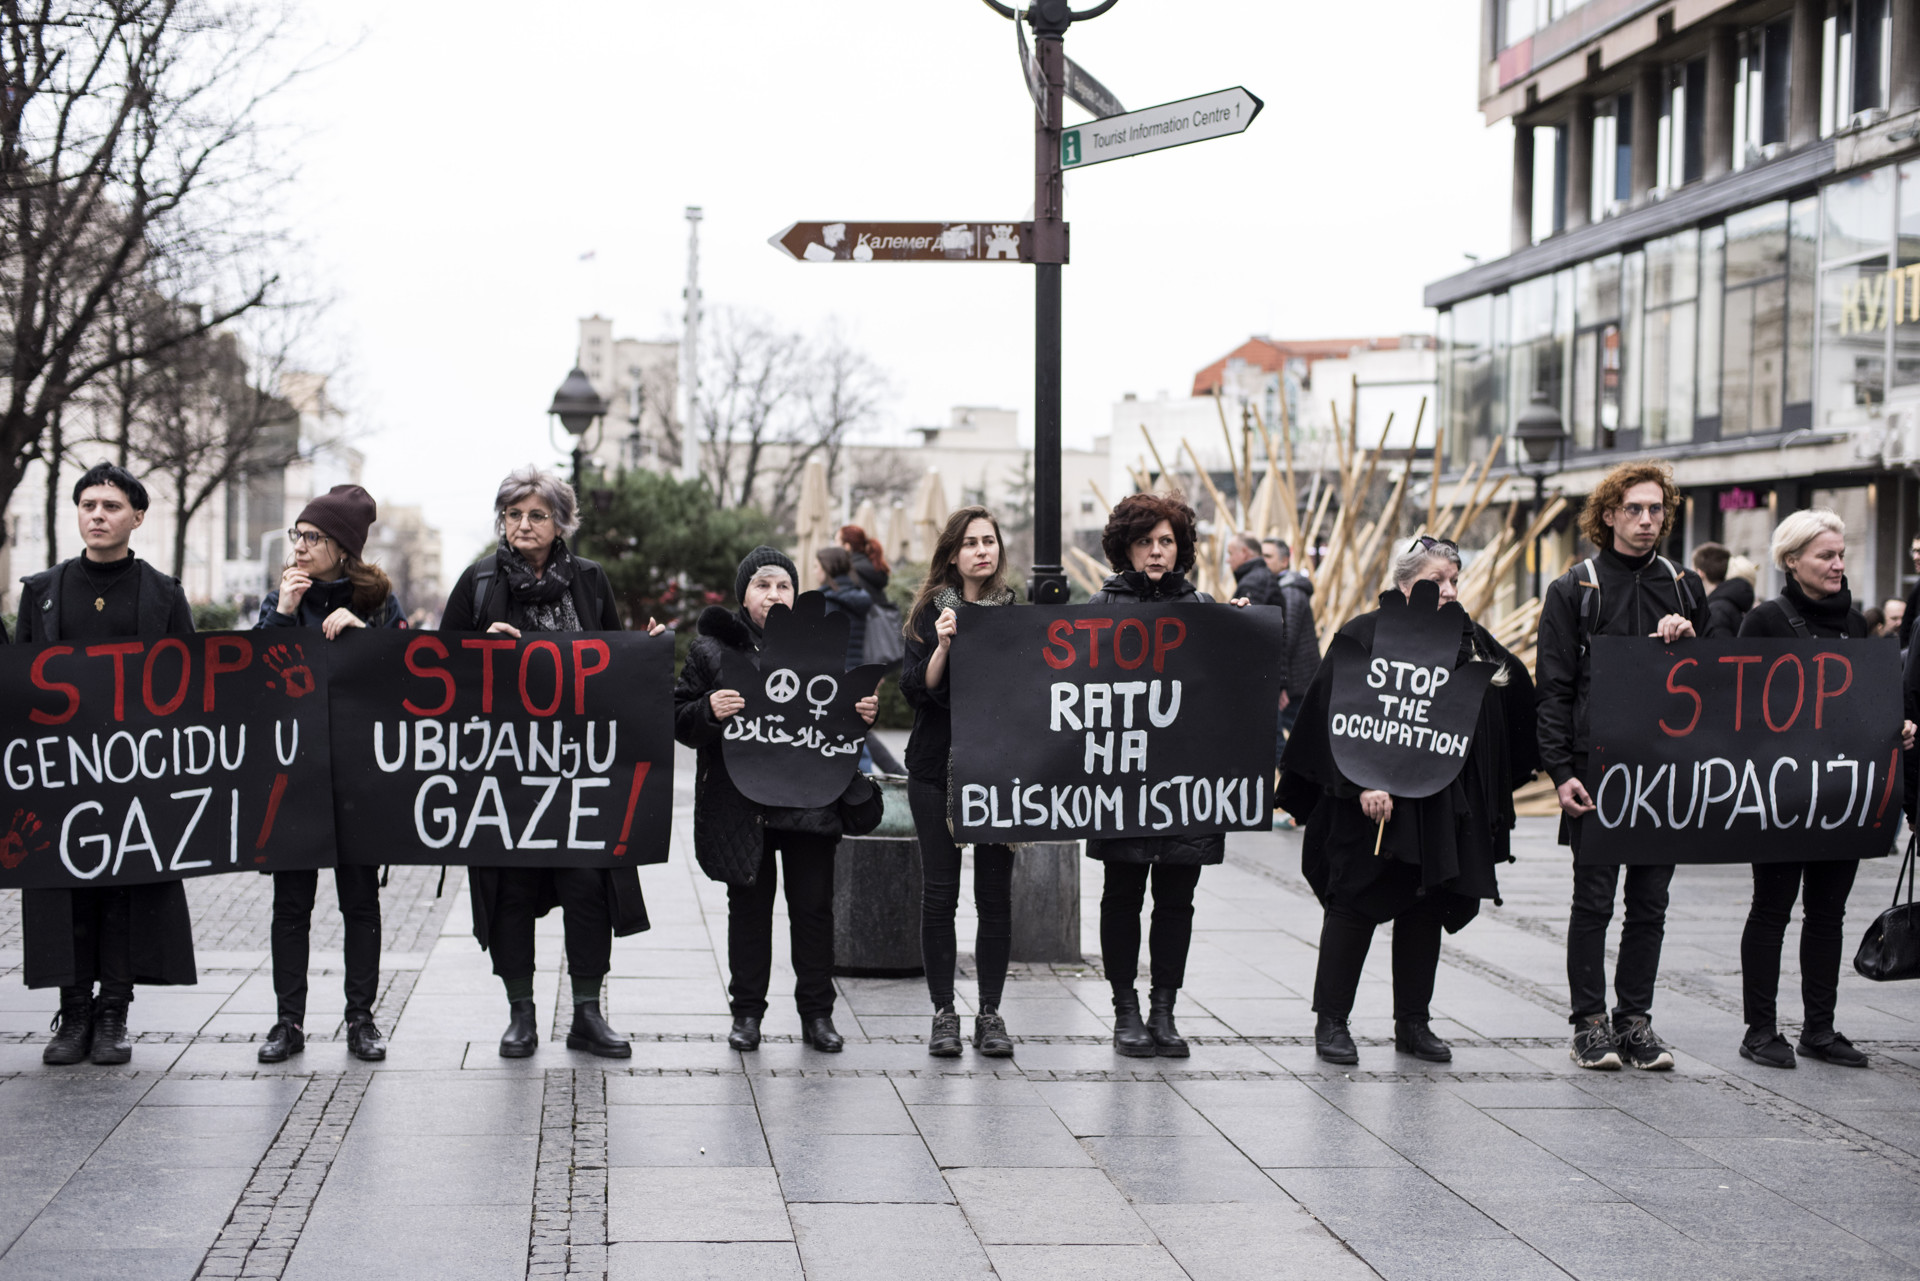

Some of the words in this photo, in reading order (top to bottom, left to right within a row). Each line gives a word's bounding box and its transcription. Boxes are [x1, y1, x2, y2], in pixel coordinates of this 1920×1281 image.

[1093, 132, 1127, 149] Tourist
[1129, 117, 1189, 142] Information
[1193, 109, 1231, 127] Centre
[1235, 102, 1241, 118] 1
[1042, 616, 1187, 673] STOP
[29, 636, 253, 725] STOP
[401, 634, 611, 717] STOP
[1366, 657, 1450, 698] STOP
[1658, 652, 1853, 738] STOP
[1050, 679, 1182, 731] RATU
[1377, 693, 1432, 723] THE
[3, 723, 246, 791] GENOCIDU
[275, 718, 299, 766] U
[1331, 713, 1469, 757] OCCUPATION
